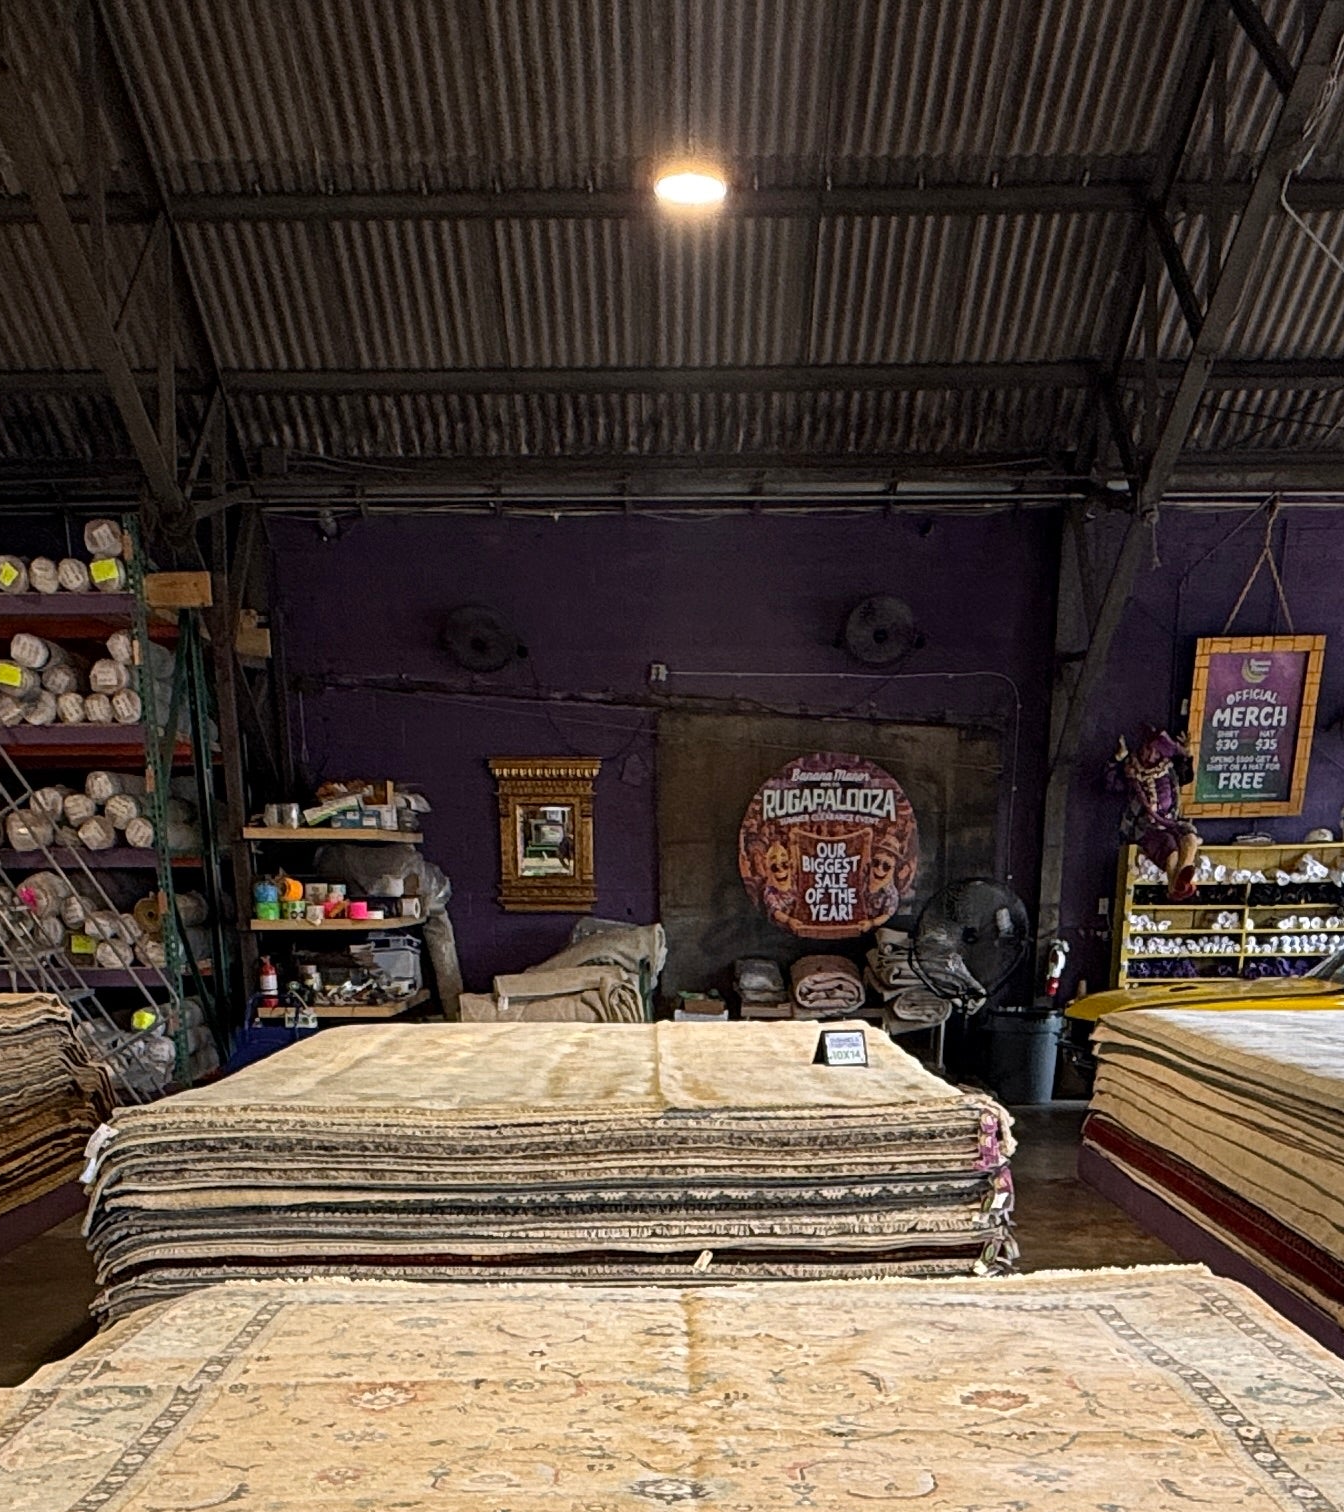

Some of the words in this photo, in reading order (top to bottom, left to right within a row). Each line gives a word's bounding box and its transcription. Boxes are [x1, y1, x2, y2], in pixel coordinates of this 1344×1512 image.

[1226, 688, 1279, 705] OFFICIAL
[1212, 706, 1288, 727] MERCH
[1259, 730, 1276, 738] HAT
[1216, 739, 1239, 752] $30
[1256, 739, 1278, 752] $35
[791, 768, 833, 781] Banana
[1218, 772, 1266, 789] FREE
[763, 788, 896, 821] RUGAPALOOZA
[816, 842, 846, 857] OUR
[802, 855, 861, 872] BIGGEST
[814, 874, 848, 888] SALE
[805, 889, 825, 904] OF
[830, 888, 858, 904] THE
[809, 904, 853, 922] YEAR!
